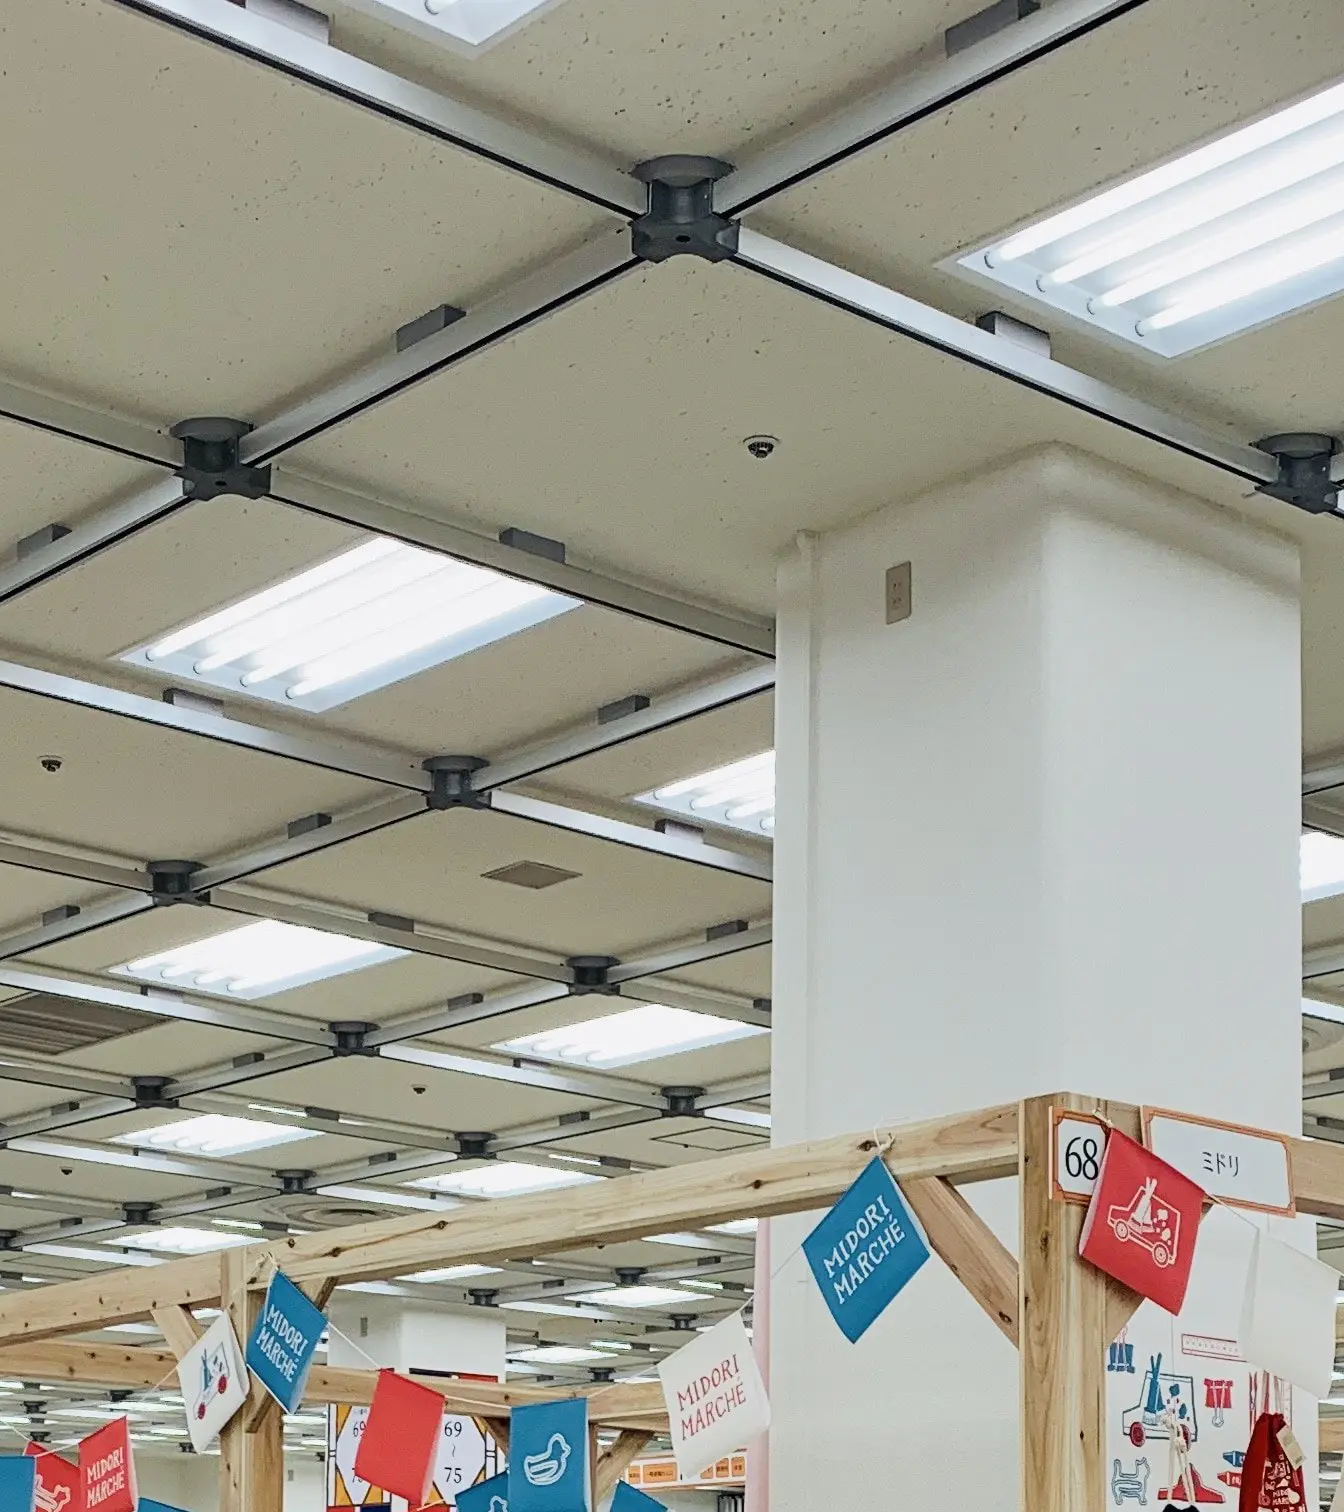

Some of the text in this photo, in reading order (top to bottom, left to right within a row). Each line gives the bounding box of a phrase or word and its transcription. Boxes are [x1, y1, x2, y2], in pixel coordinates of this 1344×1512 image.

[1064, 1136, 1100, 1181] 68
[1202, 1151, 1241, 1178] ミドリ
[822, 1194, 892, 1279] MIDORI
[834, 1215, 906, 1305] MARCHÉ
[255, 1326, 299, 1383] MARCHÉ
[265, 1302, 310, 1358] MIDORI
[677, 1353, 741, 1412] MIDORI
[444, 1421, 463, 1438] 69
[681, 1378, 747, 1442] MARCHÉ
[86, 1447, 126, 1485] MIDORI
[86, 1468, 126, 1509] MARCHÉ
[444, 1467, 463, 1484] 75
